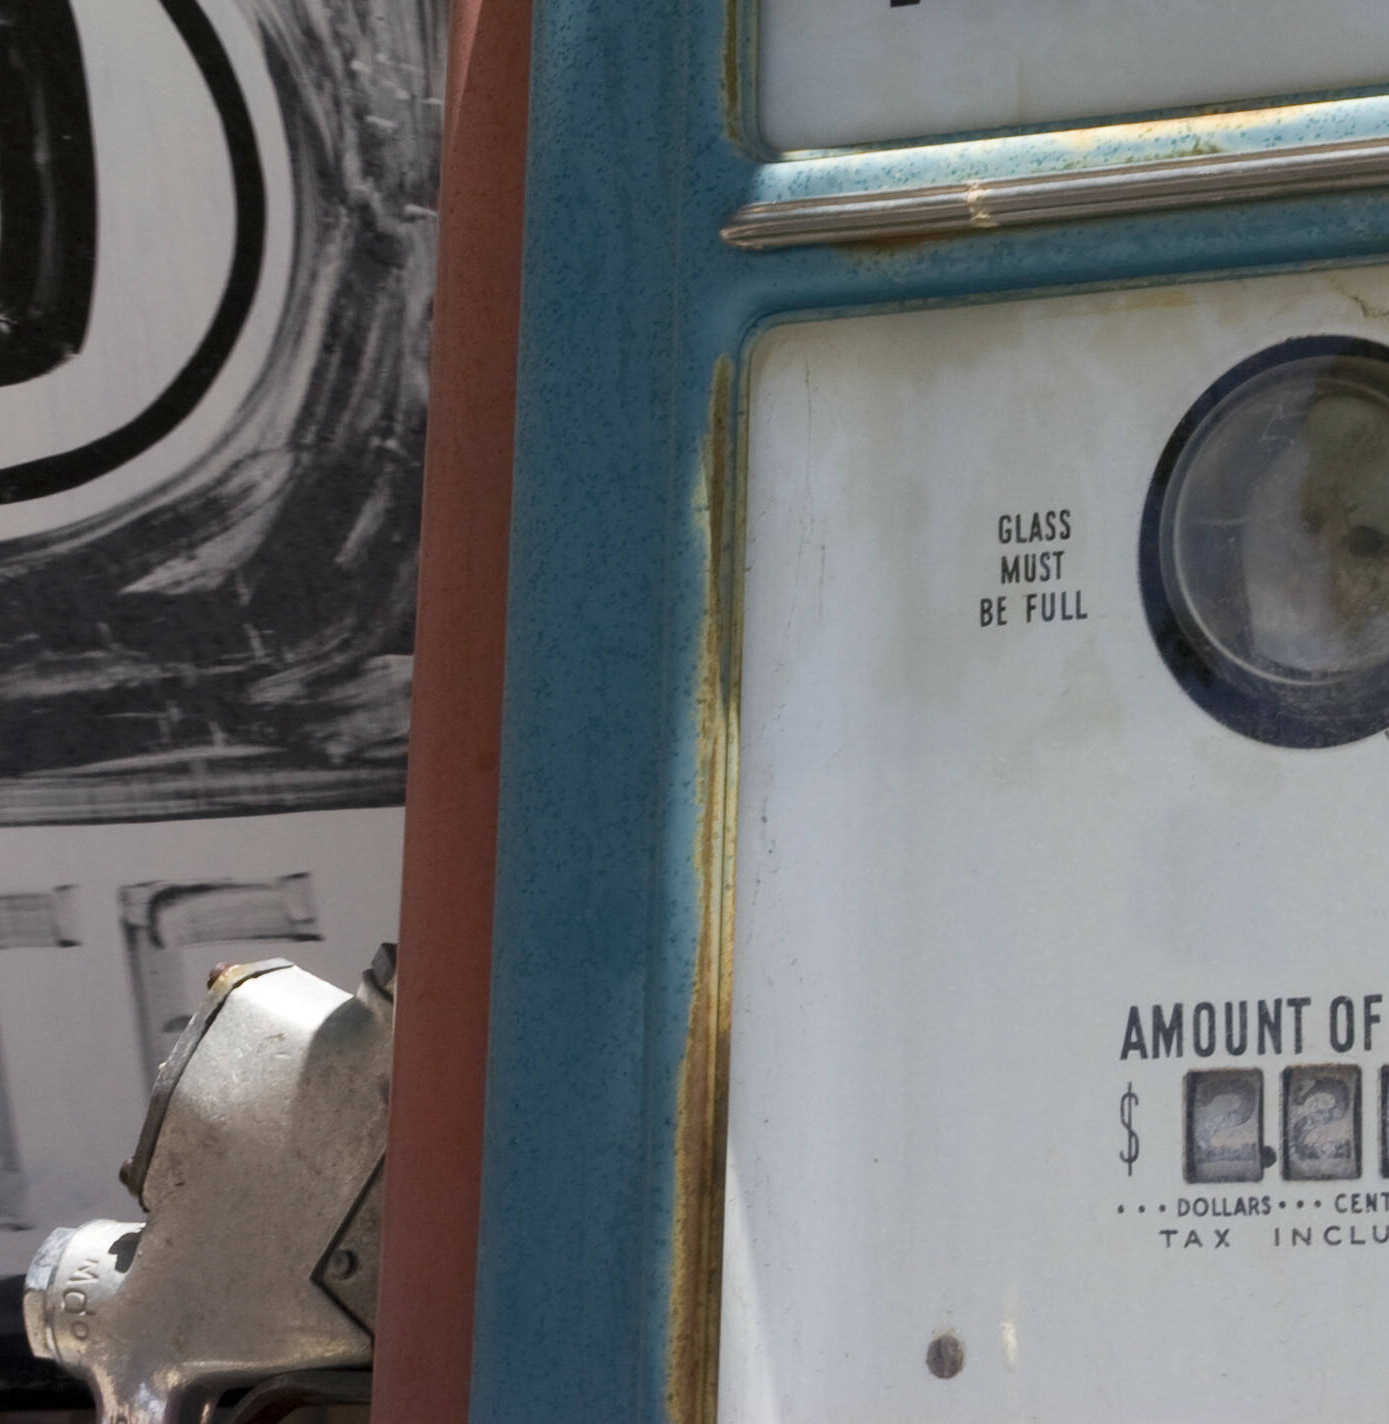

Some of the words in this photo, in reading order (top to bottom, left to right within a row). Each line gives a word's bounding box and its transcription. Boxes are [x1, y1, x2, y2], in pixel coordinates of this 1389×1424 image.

[998, 509, 1071, 544] GLASS
[1001, 550, 1065, 584] MUST
[980, 596, 1007, 627] BE
[1025, 590, 1088, 623] FULL
[1120, 996, 1312, 1060] AMOUNT
[1329, 994, 1383, 1053] OF
[1177, 1196, 1272, 1218] DOLLARS
[1159, 1228, 1230, 1249] TAX
